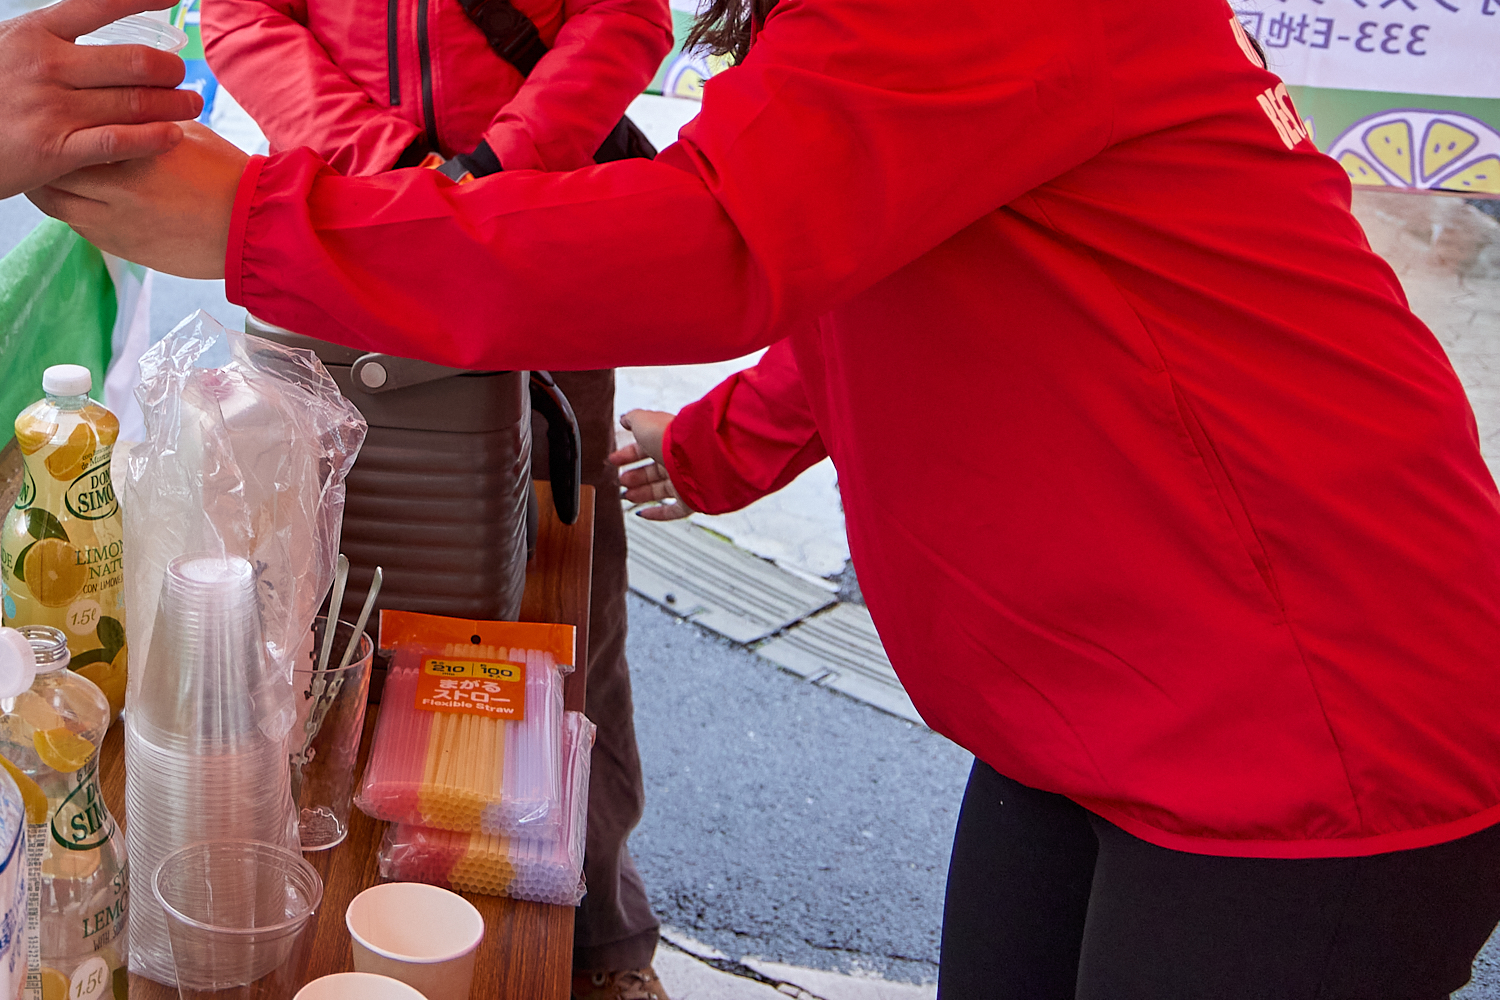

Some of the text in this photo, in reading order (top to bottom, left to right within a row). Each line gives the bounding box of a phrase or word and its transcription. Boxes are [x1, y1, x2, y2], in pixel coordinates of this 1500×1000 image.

[432, 664, 513, 677] 210 100
[440, 679, 501, 693] まがる
[433, 688, 510, 703] ストロー
[422, 698, 514, 714] Flexible Straw
